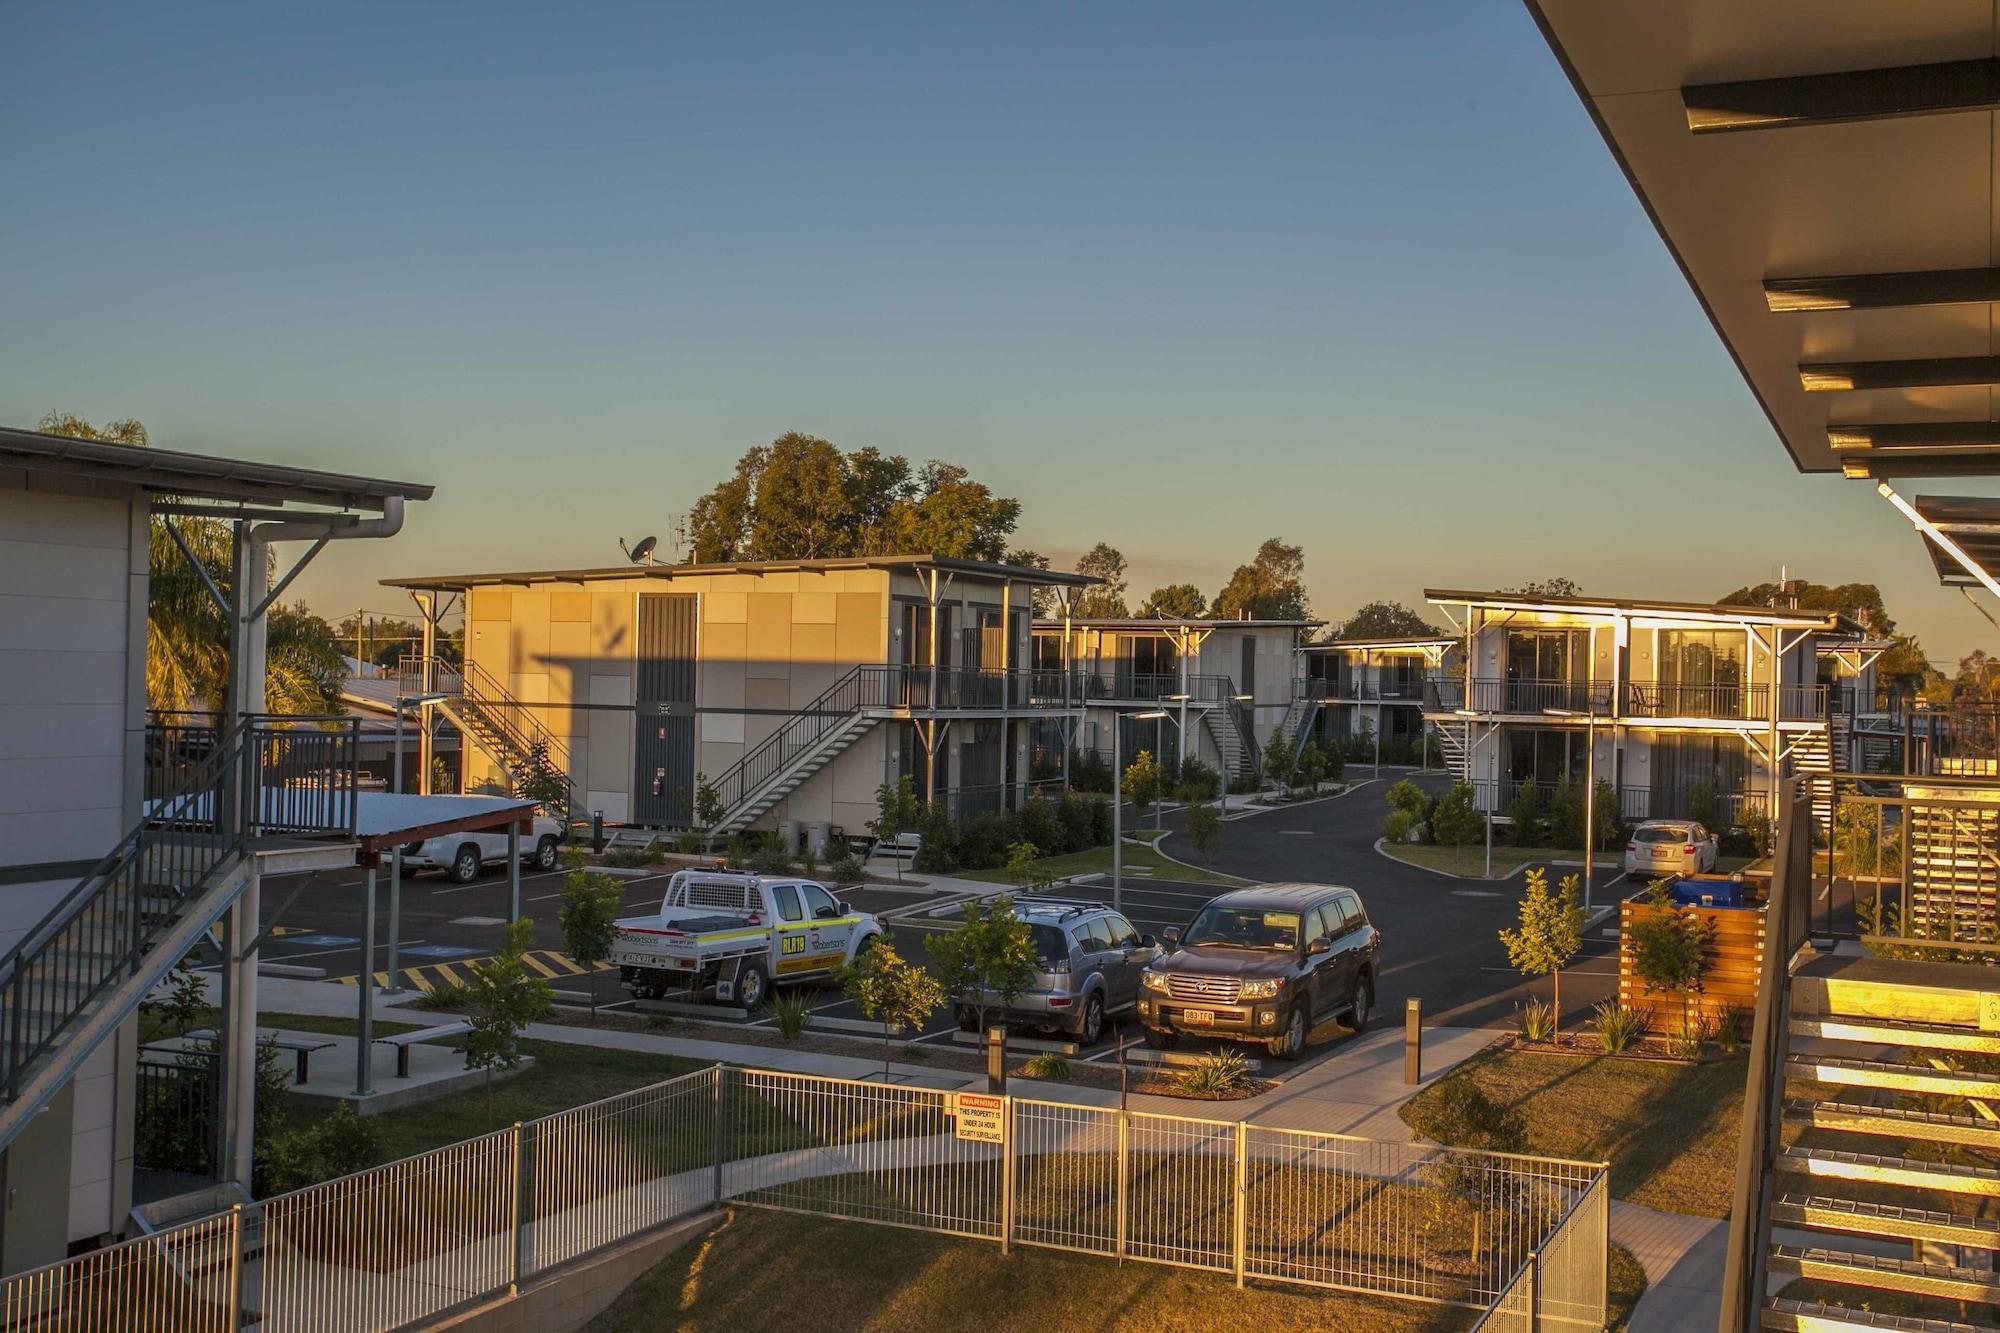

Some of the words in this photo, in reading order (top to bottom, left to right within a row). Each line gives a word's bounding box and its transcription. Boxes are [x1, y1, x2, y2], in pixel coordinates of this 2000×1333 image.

[783, 936, 804, 954] RLR19
[961, 1096, 999, 1108] WARNING
[960, 1108, 970, 1116] THIS
[971, 1109, 995, 1118] PROPERTY
[964, 1119, 977, 1128] UNDER
[978, 1120, 984, 1128] 24
[984, 1121, 996, 1129] HOUR
[960, 1129, 976, 1137] SECURITY
[976, 1131, 1001, 1140] SURVEILLANCE
